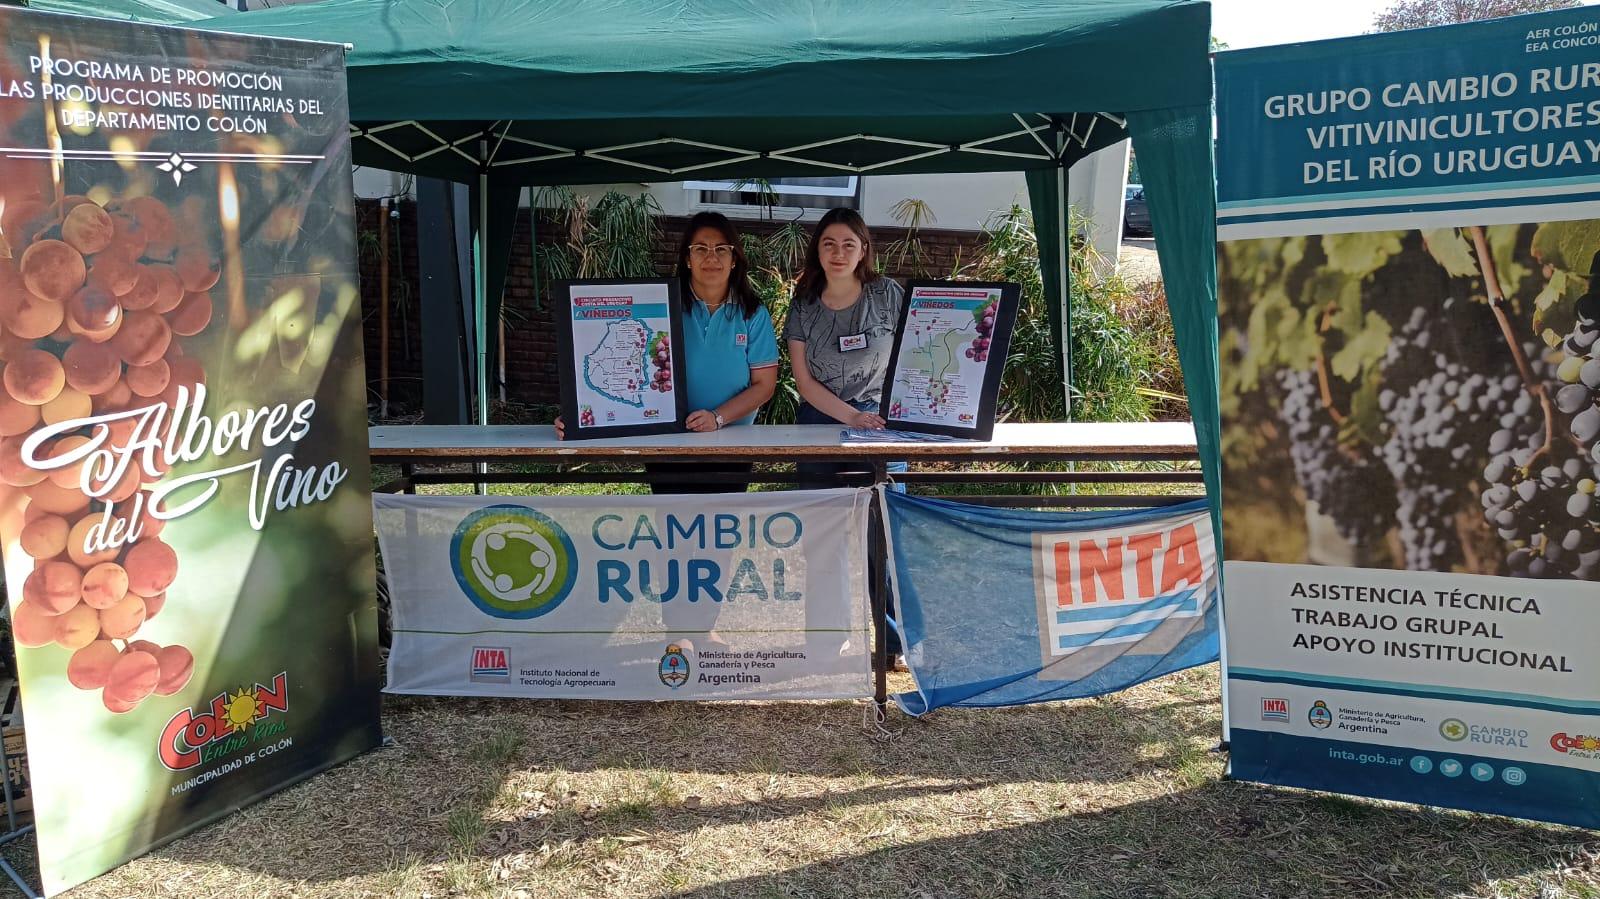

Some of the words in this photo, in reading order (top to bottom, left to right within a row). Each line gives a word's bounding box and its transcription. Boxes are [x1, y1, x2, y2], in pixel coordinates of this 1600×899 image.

[1526, 29, 1550, 40] AER
[1554, 21, 1598, 37] COLÓN
[1525, 42, 1549, 53] EEA
[30, 55, 143, 82] PROGRAMA
[151, 67, 171, 84] DE
[177, 69, 282, 92] PROMOCIÓN
[0, 80, 36, 99] LAS
[42, 81, 193, 109] PRODUCCIONES
[198, 95, 294, 114] IDENTITARIAS
[299, 99, 324, 115] DEL
[1264, 88, 1371, 119] GRUPO
[1382, 72, 1518, 108] CAMBIO
[61, 108, 200, 132] DEPARTAMENTO
[207, 115, 267, 134] COLÓN
[1306, 100, 1600, 150] VITIVINICULTORES
[1303, 160, 1359, 185] DEL
[1368, 150, 1422, 180] RÍO
[1433, 139, 1600, 176] URUGUAY
[582, 307, 632, 318] VIÑEDOS
[21, 382, 316, 498] Albores
[83, 493, 144, 555] del
[147, 453, 348, 531] Vino
[592, 511, 803, 550] CAMBIO
[1053, 523, 1203, 606] INTA
[596, 558, 802, 604] RURAL
[1290, 582, 1427, 606] ASISTENCIA
[1434, 588, 1541, 615] TÉCNICA
[1292, 608, 1398, 631] TRABAJO
[1406, 617, 1503, 639] GRUPAL
[474, 650, 507, 668] INTA
[698, 651, 740, 659] Ministerio
[743, 651, 754, 659] de
[756, 651, 806, 661] Agricultura,
[1293, 633, 1376, 655] APOYO
[1384, 641, 1573, 673] INSTITUCIONAL
[520, 668, 553, 677] Instituto
[555, 669, 588, 677] Nacional
[590, 669, 600, 677] de
[699, 660, 741, 669] Ganadería
[744, 662, 750, 670] y
[751, 661, 776, 669] Pesca
[564, 679, 616, 688] Agropecuaria
[698, 672, 761, 686] Argentina
[1263, 700, 1287, 713] INTA
[1338, 707, 1374, 717] Ministerio
[1374, 711, 1384, 719] de
[1385, 712, 1426, 723] Agricultura,
[1338, 714, 1375, 723] Ganadería
[1380, 717, 1401, 726] Pesca
[1338, 722, 1388, 735] Argentina
[1470, 724, 1529, 739] CAMBIO
[1470, 733, 1529, 748] RURAL
[203, 735, 249, 764] Entre
[1329, 748, 1404, 766] inta.gob.ar
[171, 758, 242, 796] MUNICIPALIDAD
[244, 752, 256, 765] DE
[258, 737, 293, 758] COLÓN
